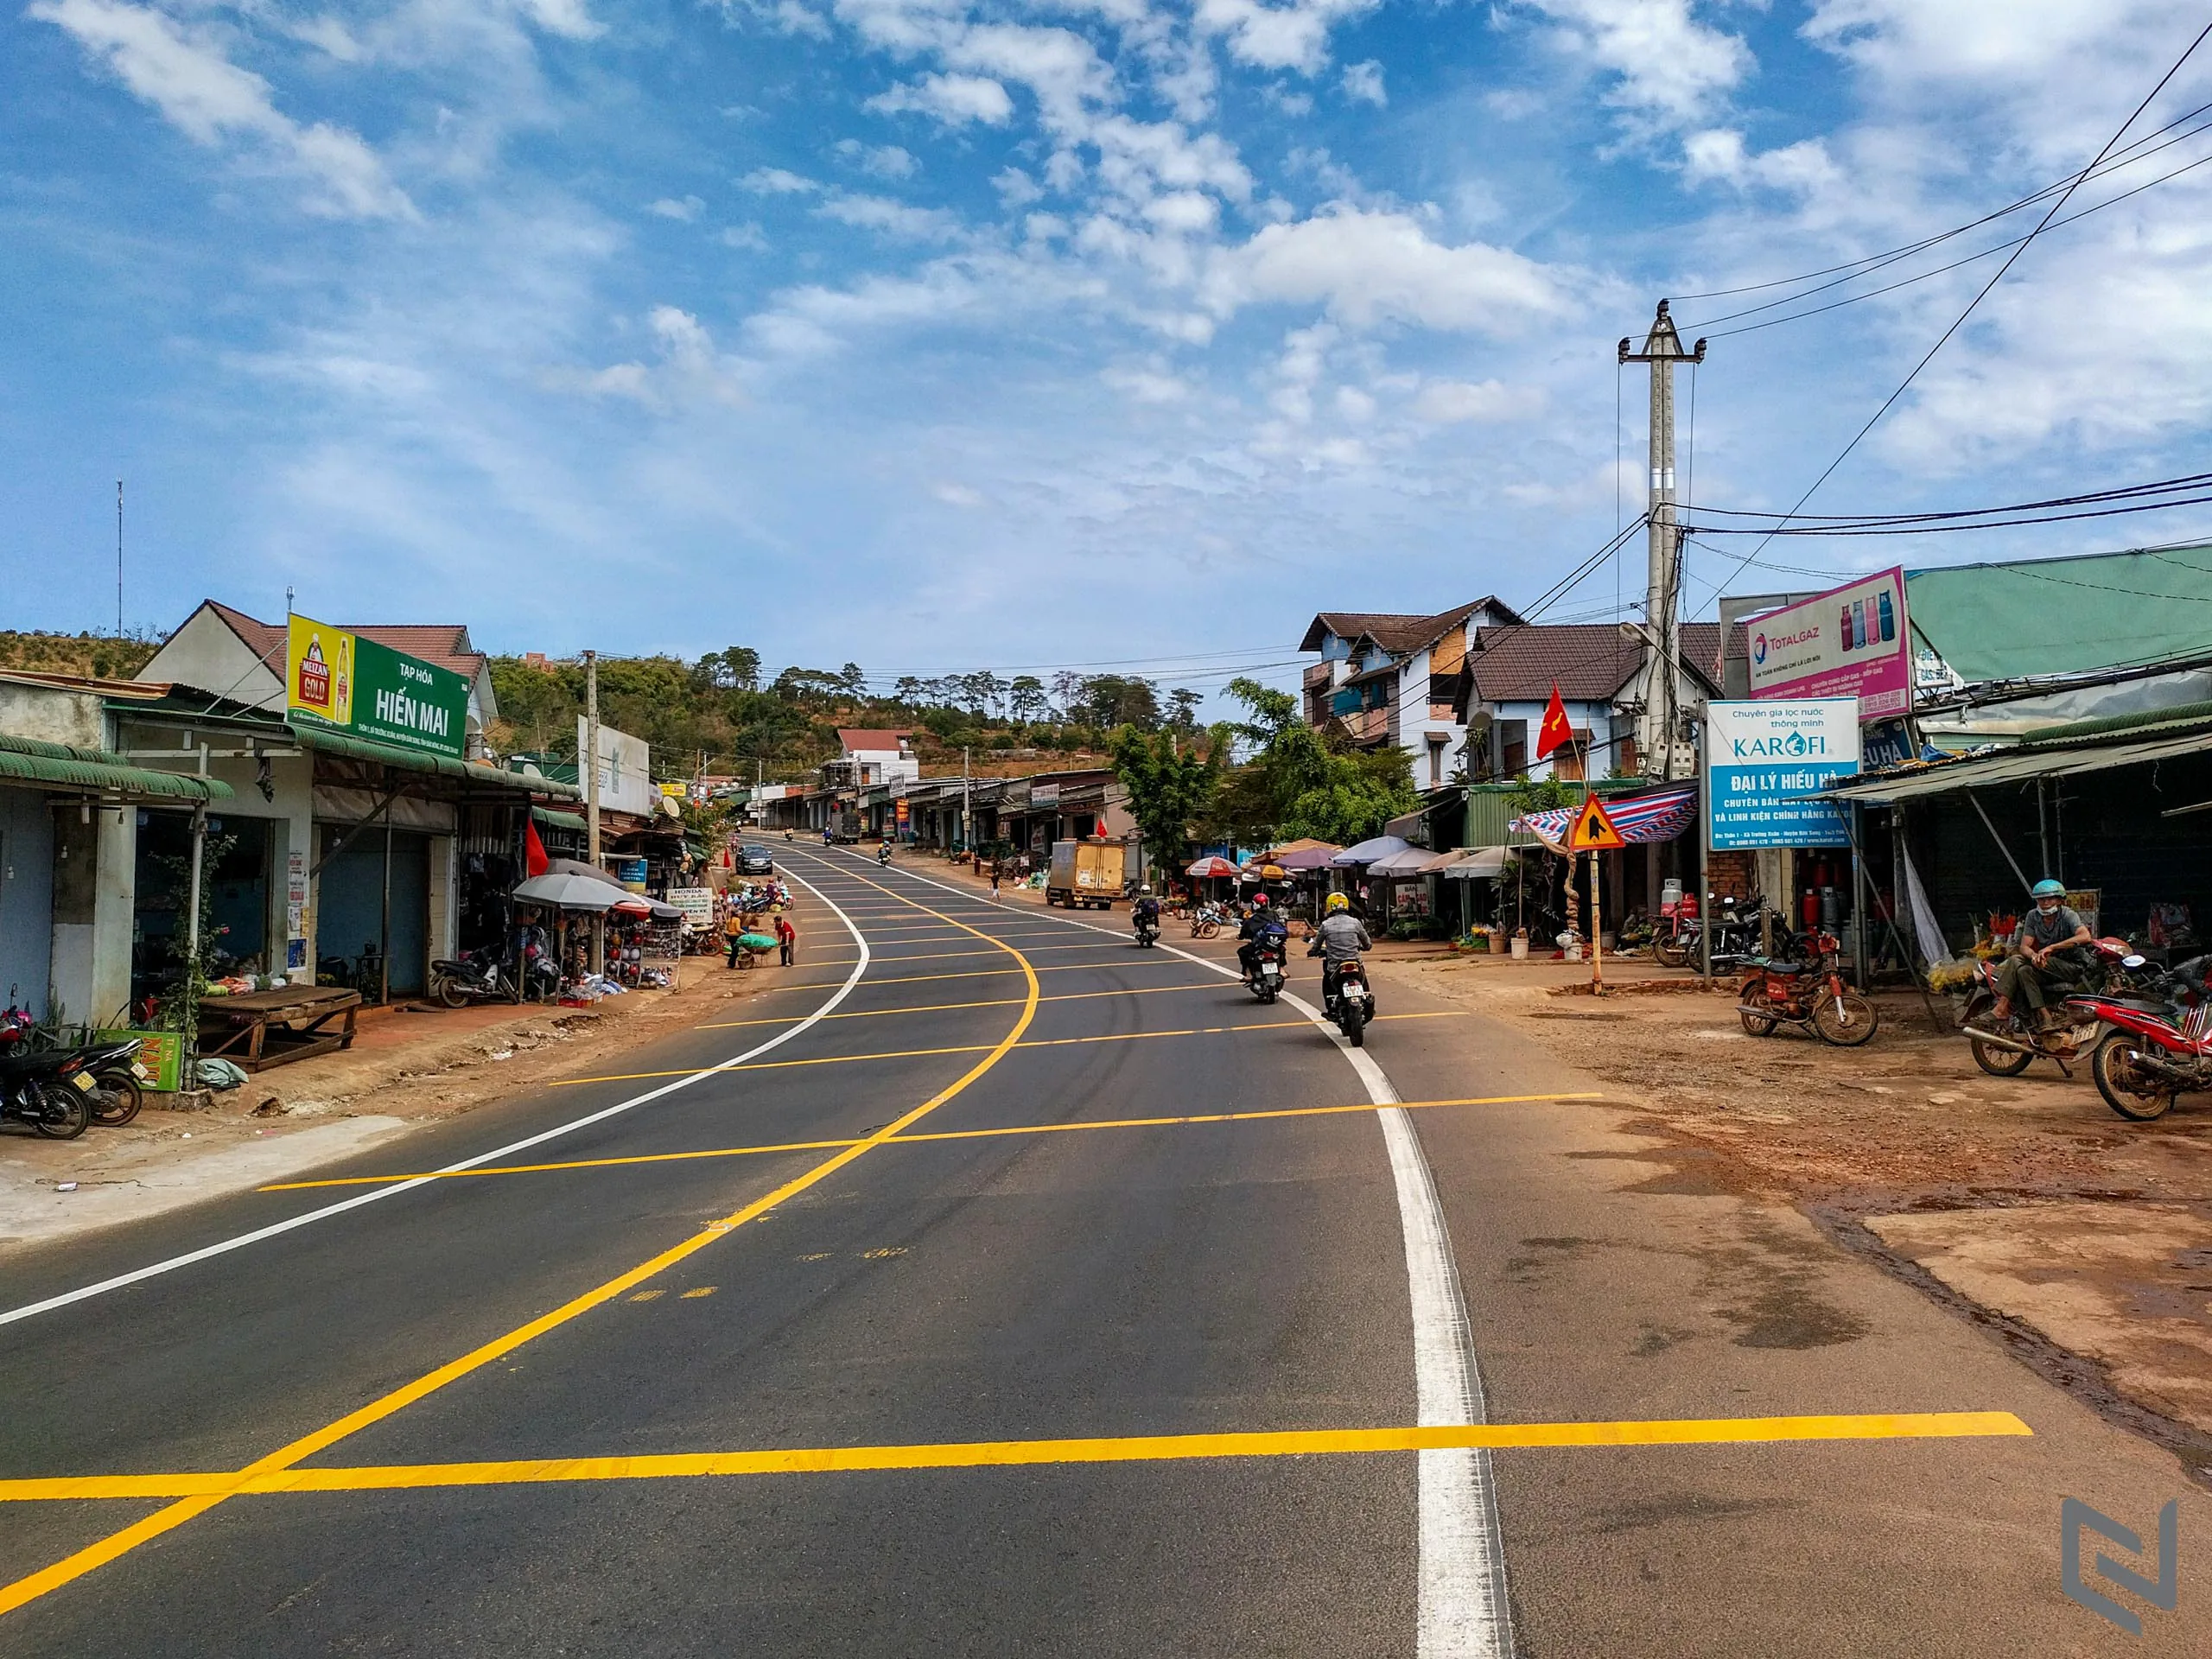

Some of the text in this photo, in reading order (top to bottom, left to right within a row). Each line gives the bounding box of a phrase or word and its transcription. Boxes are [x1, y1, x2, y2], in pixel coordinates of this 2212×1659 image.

[302, 660, 328, 677] MEIZAN
[399, 663, 433, 685] TẠP HÓA
[304, 677, 325, 701] GOLD
[376, 687, 449, 737] HIẾN MAI
[1732, 709, 1766, 719] Chuyên
[1770, 709, 1783, 718] gia
[1785, 709, 1799, 717] lọc
[1771, 719, 1824, 728] thông minh
[1733, 730, 1825, 757] KAROFI
[1732, 775, 1756, 794] ĐẠI
[1761, 772, 1777, 791] LÝ
[1782, 769, 1815, 789] HIẾU
[1724, 798, 1758, 809] CHUYÊN
[1761, 797, 1780, 807] BÁN
[1714, 810, 1726, 823] VÀ
[1729, 812, 1747, 821] LINH
[1751, 810, 1771, 823] KIỆN
[1773, 810, 1799, 820] CHÍNH
